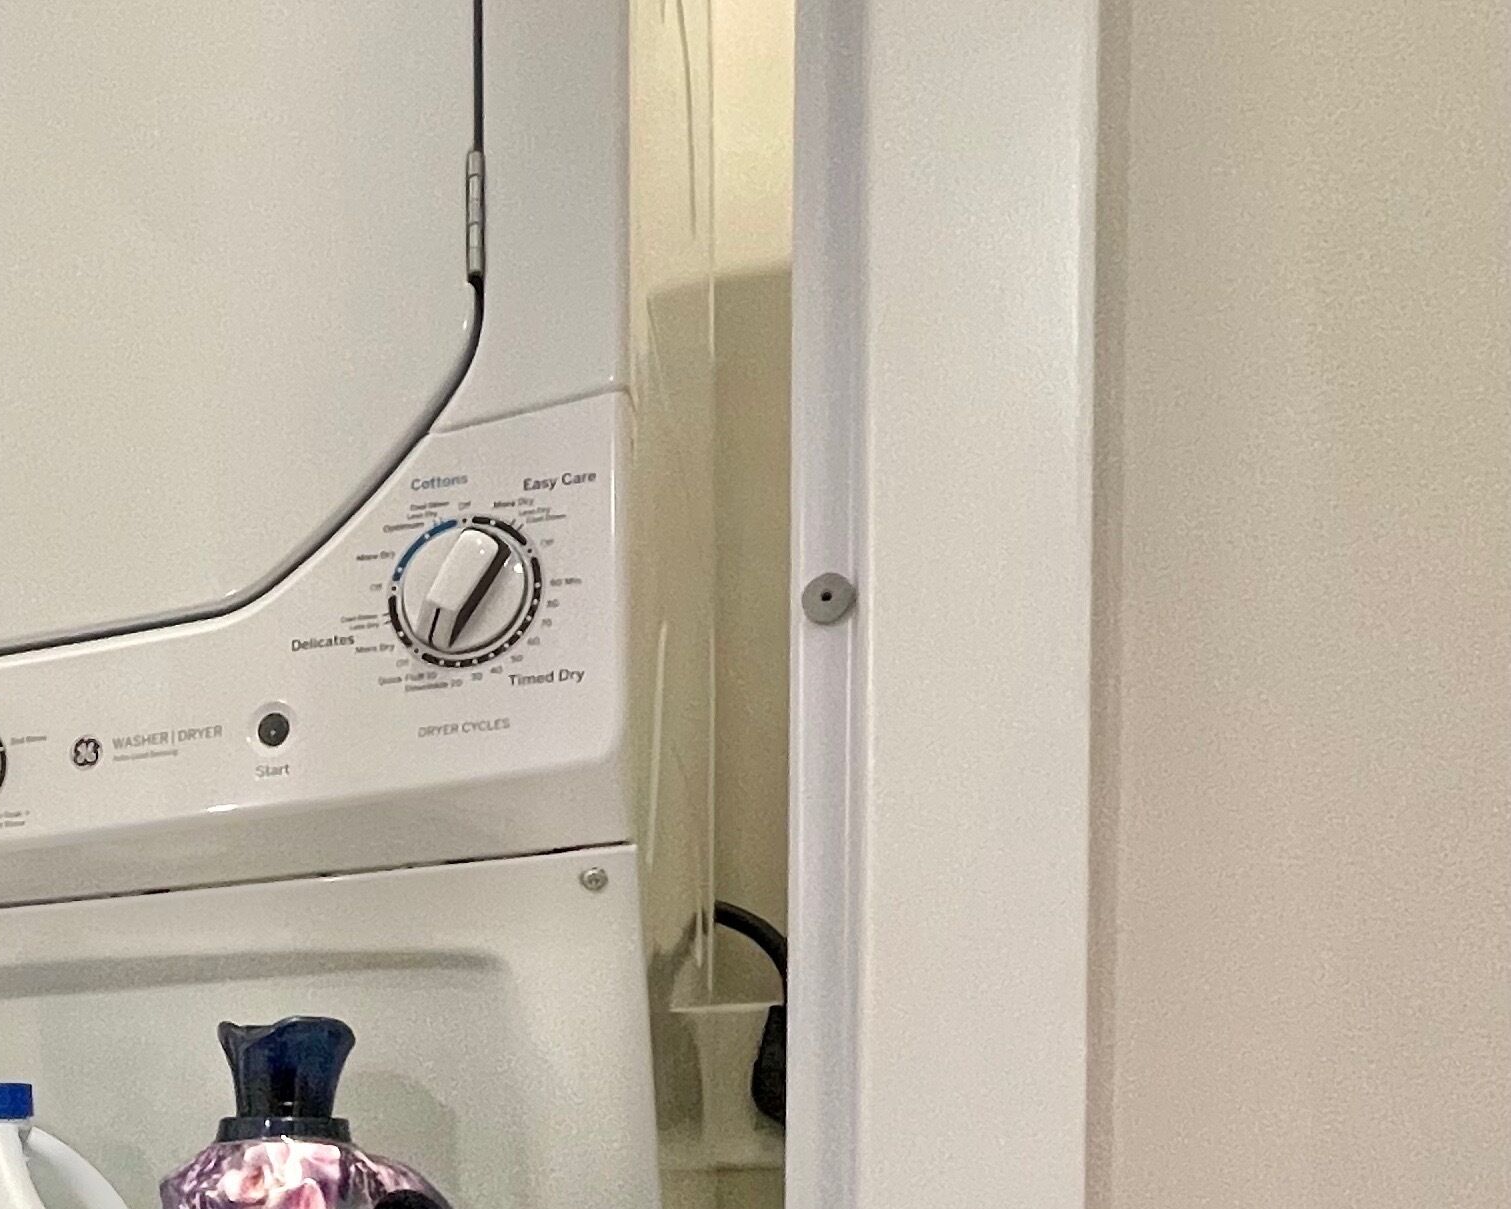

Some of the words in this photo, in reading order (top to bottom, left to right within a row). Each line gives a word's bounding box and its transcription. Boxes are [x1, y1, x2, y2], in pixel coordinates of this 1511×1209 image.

[411, 475, 468, 491] Cottons
[523, 477, 557, 492] Easy
[561, 472, 596, 487] Care
[291, 635, 355, 652] Delicates
[508, 670, 554, 686] Timed
[559, 668, 585, 683] Dry
[417, 720, 458, 738] DRYER
[461, 716, 510, 734] CYCLES
[112, 731, 169, 749] WASHER
[177, 725, 223, 743] DRYER
[255, 762, 290, 779] Start
